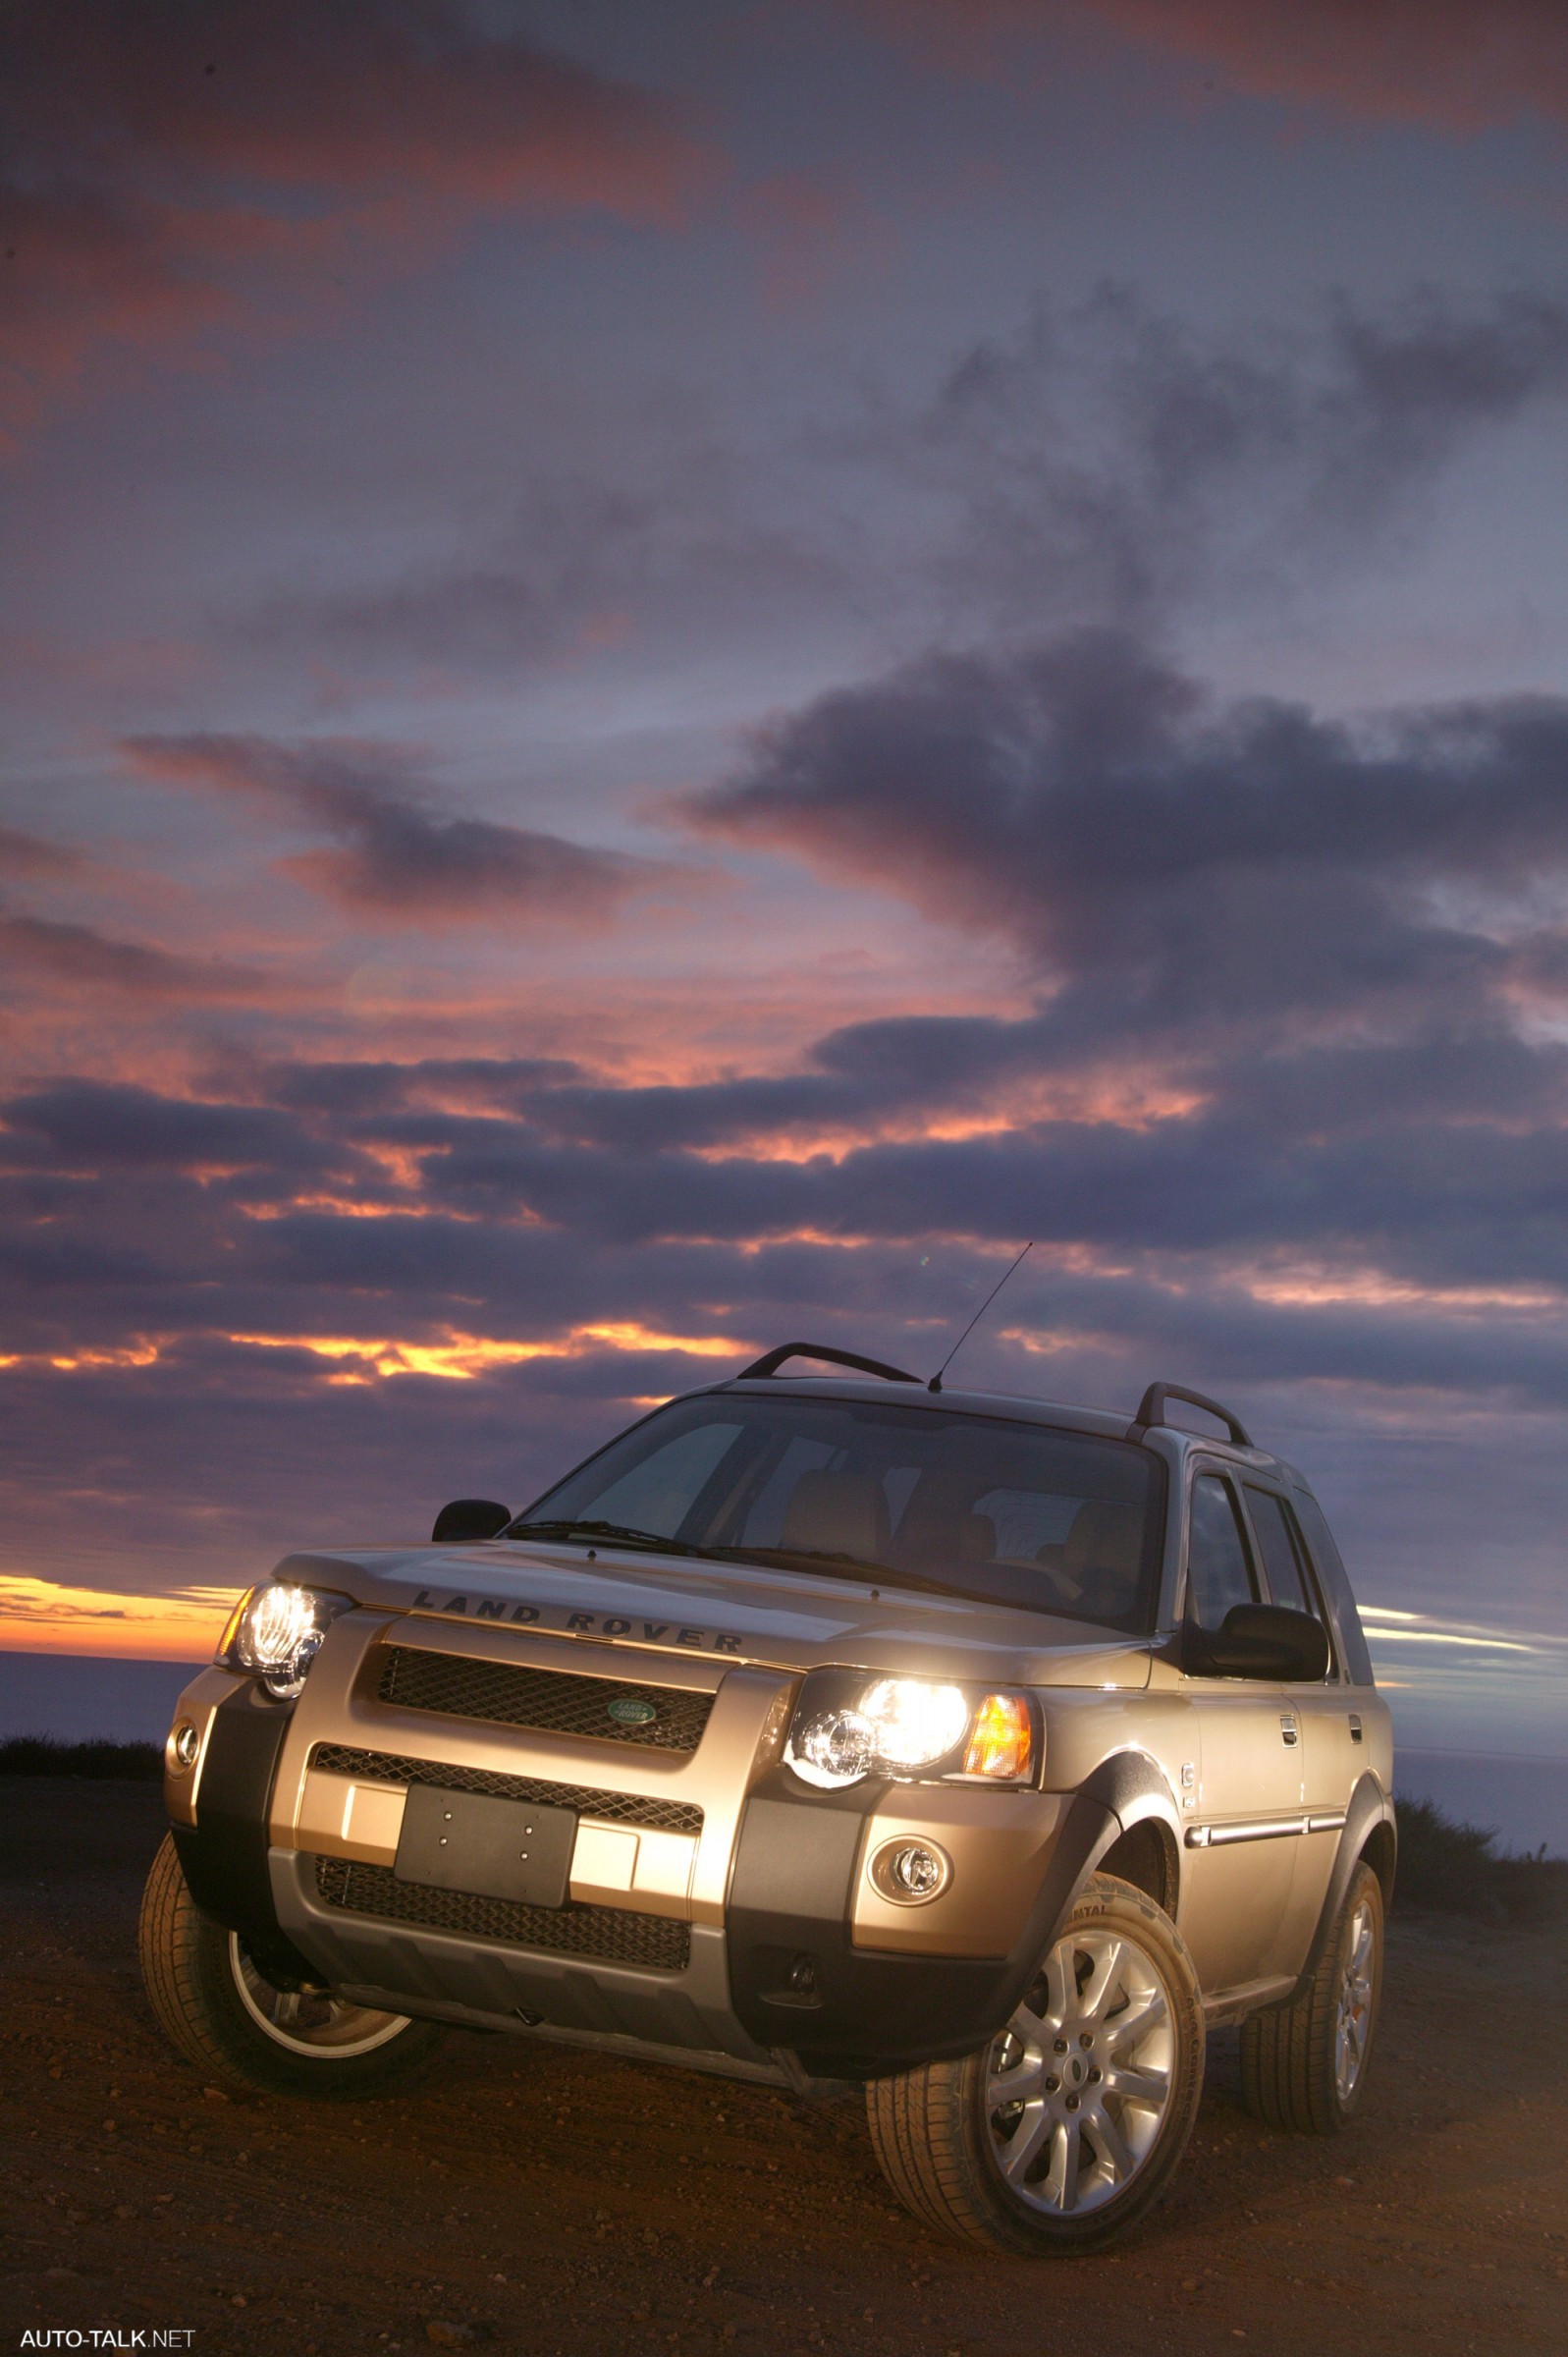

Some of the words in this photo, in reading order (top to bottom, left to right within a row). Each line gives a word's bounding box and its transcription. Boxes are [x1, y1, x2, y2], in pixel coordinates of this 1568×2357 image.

[412, 1590, 540, 1624] LAND
[567, 1613, 743, 1654] ROVER
[619, 1702, 643, 1711] LAND
[619, 1710, 648, 1721] ROVER
